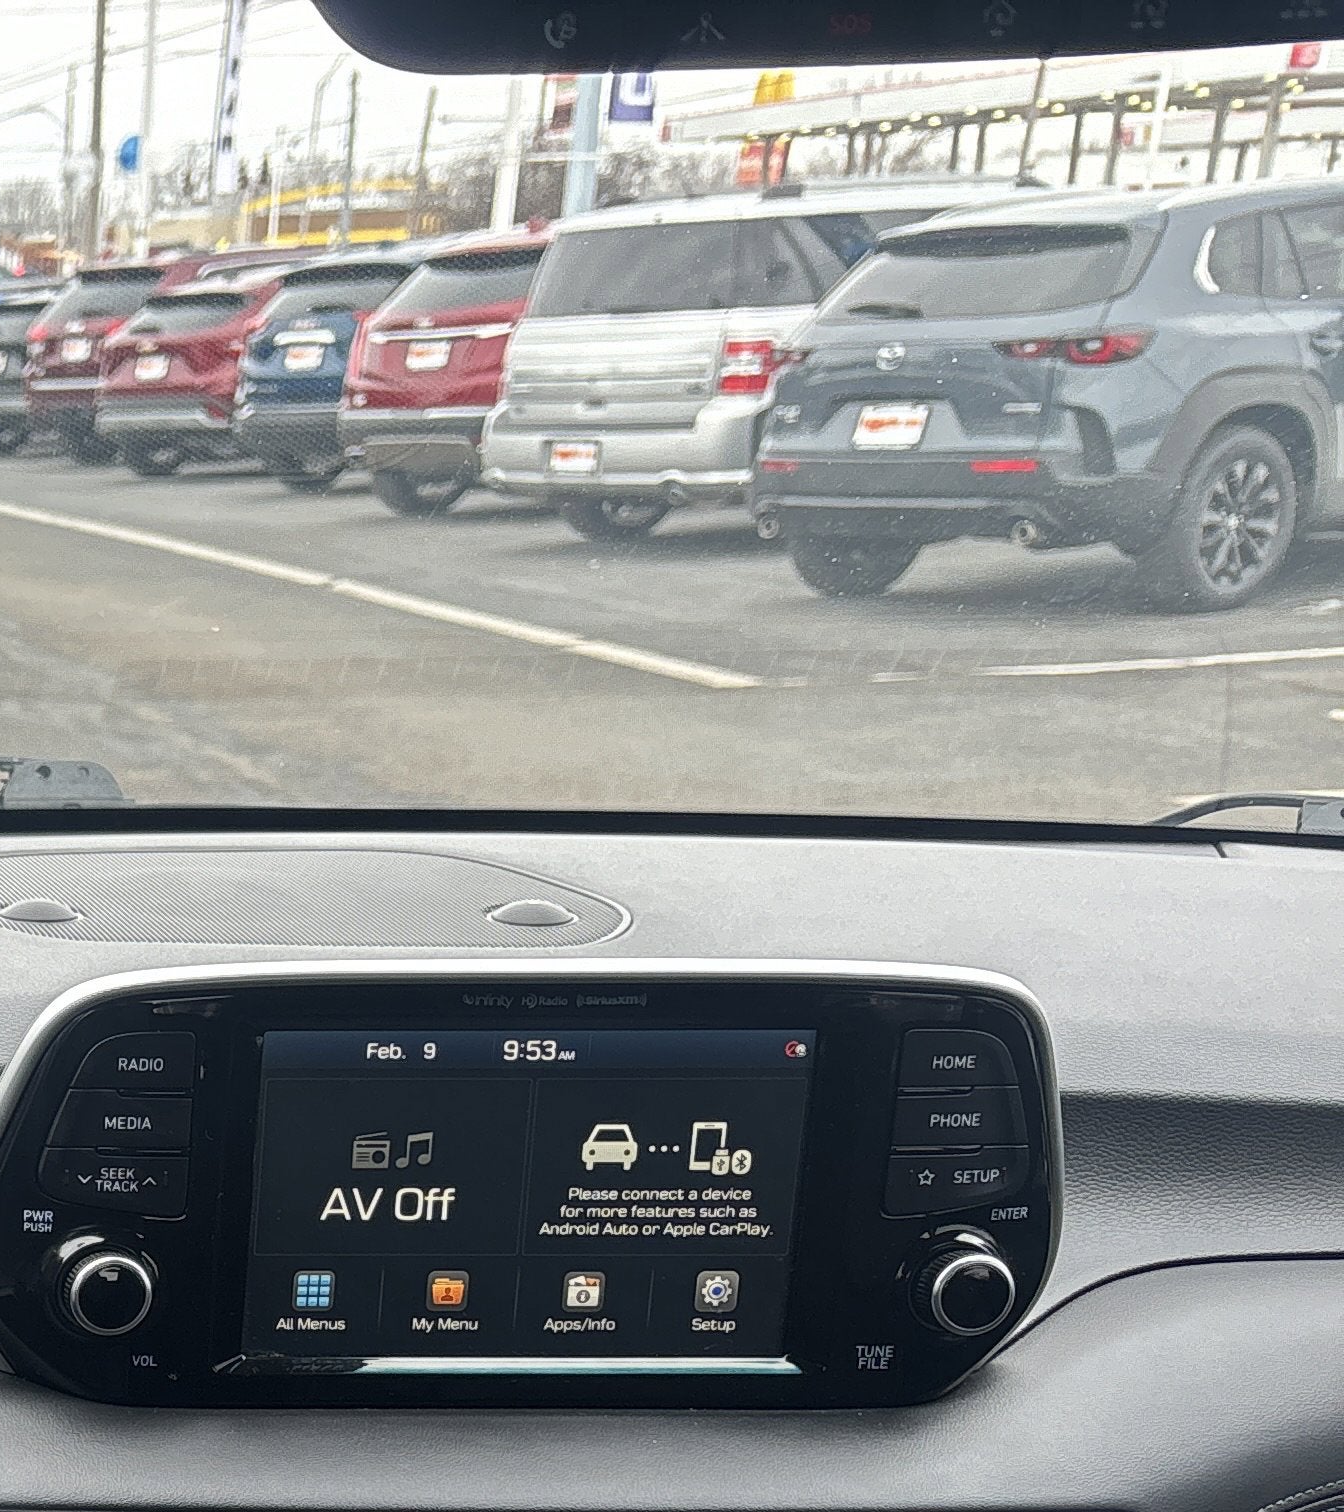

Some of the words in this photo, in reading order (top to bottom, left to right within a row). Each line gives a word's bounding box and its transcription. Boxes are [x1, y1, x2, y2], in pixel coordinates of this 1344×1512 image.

[828, 14, 872, 34] SOS
[366, 1042, 406, 1059] Feb.
[423, 1042, 436, 1059] 9
[117, 1058, 164, 1072] RADIO
[932, 1055, 977, 1070] HOME
[104, 1116, 152, 1130] MEDIA
[929, 1113, 982, 1128] PHONE
[100, 1168, 136, 1180] SEEK
[953, 1168, 1000, 1184] SETUP
[95, 1180, 139, 1192] TRACK
[568, 1187, 618, 1201] Please
[621, 1187, 684, 1201] connect
[688, 1190, 698, 1201] a
[701, 1187, 752, 1201] device
[320, 1187, 384, 1221] AV
[394, 1187, 456, 1221] Off
[23, 1209, 54, 1222] PWR
[560, 1205, 583, 1218] for
[586, 1207, 627, 1218] more
[631, 1205, 696, 1218] features
[699, 1205, 735, 1218] such
[738, 1207, 757, 1218] as
[990, 1206, 1029, 1221] ENTER
[23, 1222, 52, 1233] PUSH
[538, 1222, 599, 1236] Android
[602, 1222, 639, 1236] Auto
[641, 1225, 660, 1236] or
[662, 1222, 706, 1238] Apple
[709, 1222, 774, 1238] CarPlay.
[276, 1317, 294, 1331] All
[297, 1317, 346, 1331] Menus
[412, 1318, 434, 1334] My
[437, 1318, 478, 1331] Menu
[543, 1318, 616, 1334] Apps/Info
[691, 1318, 736, 1334] Setup
[855, 1345, 894, 1358] TUNE
[132, 1355, 158, 1367] VOL
[857, 1357, 890, 1370] FILE
